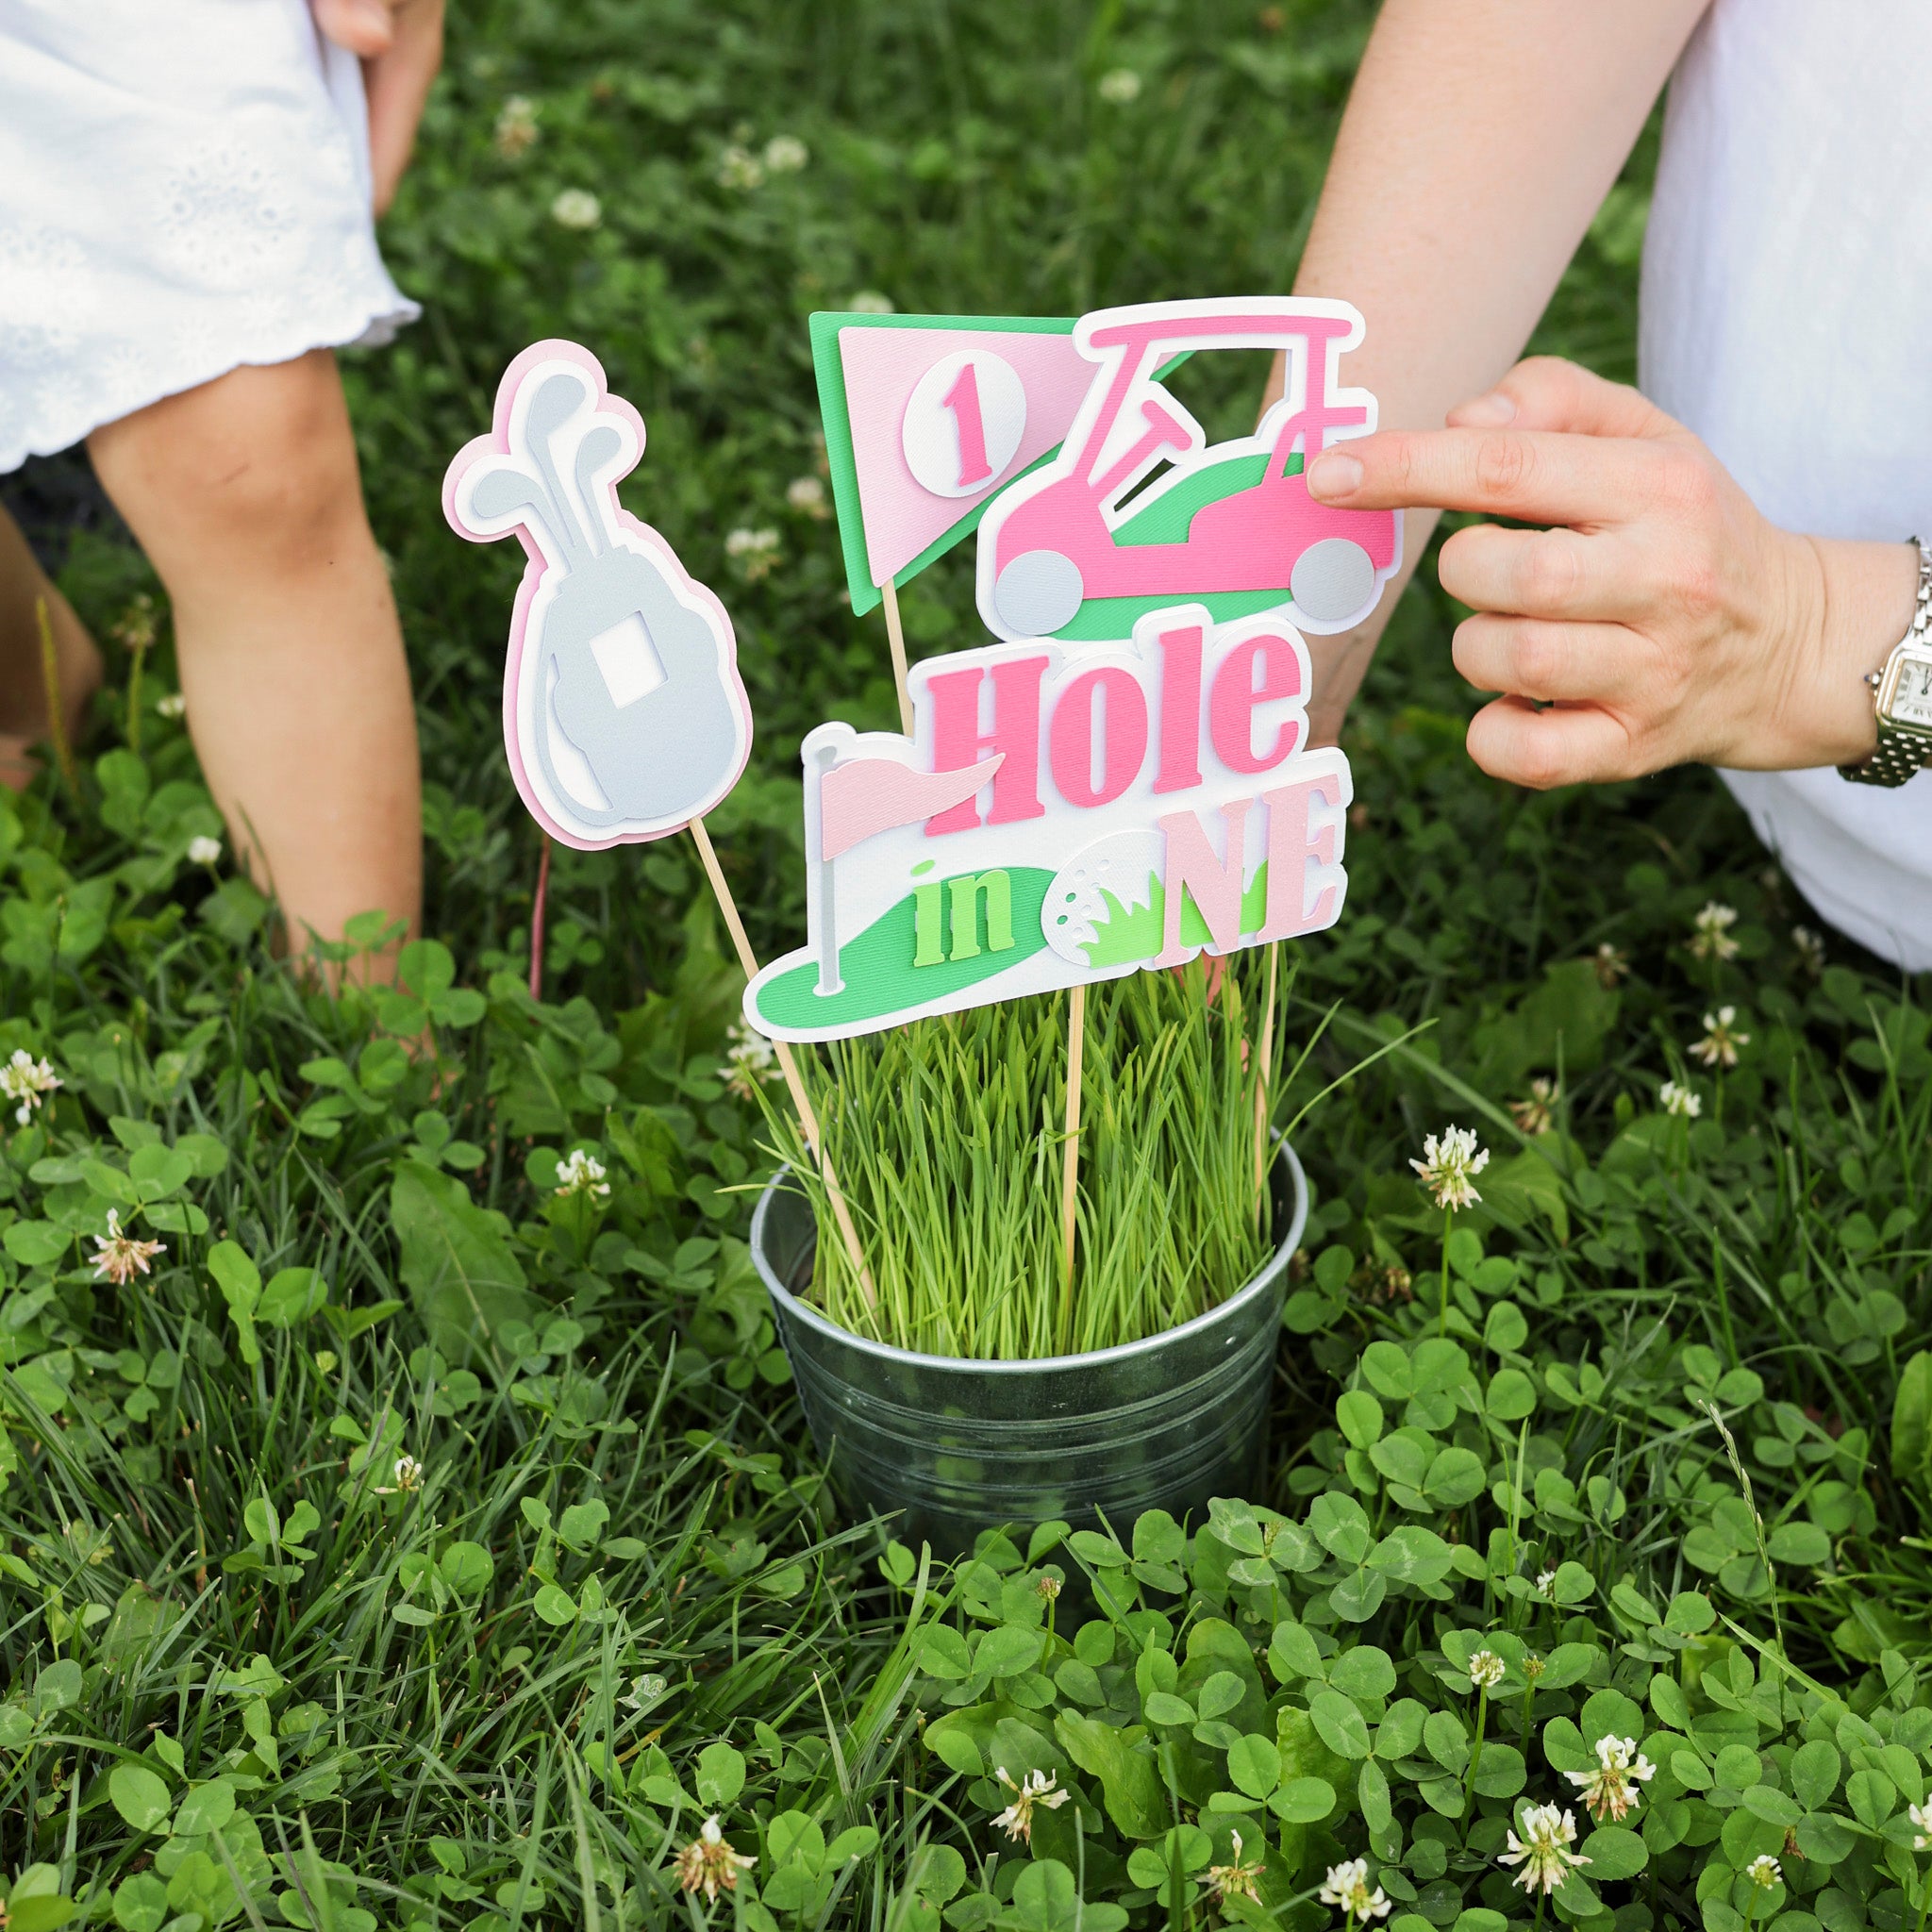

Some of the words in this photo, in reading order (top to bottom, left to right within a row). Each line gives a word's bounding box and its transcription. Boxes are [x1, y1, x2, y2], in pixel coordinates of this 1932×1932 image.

[943, 362, 992, 488] 1
[924, 625, 1302, 838] Hole
[910, 859, 1016, 968] in
